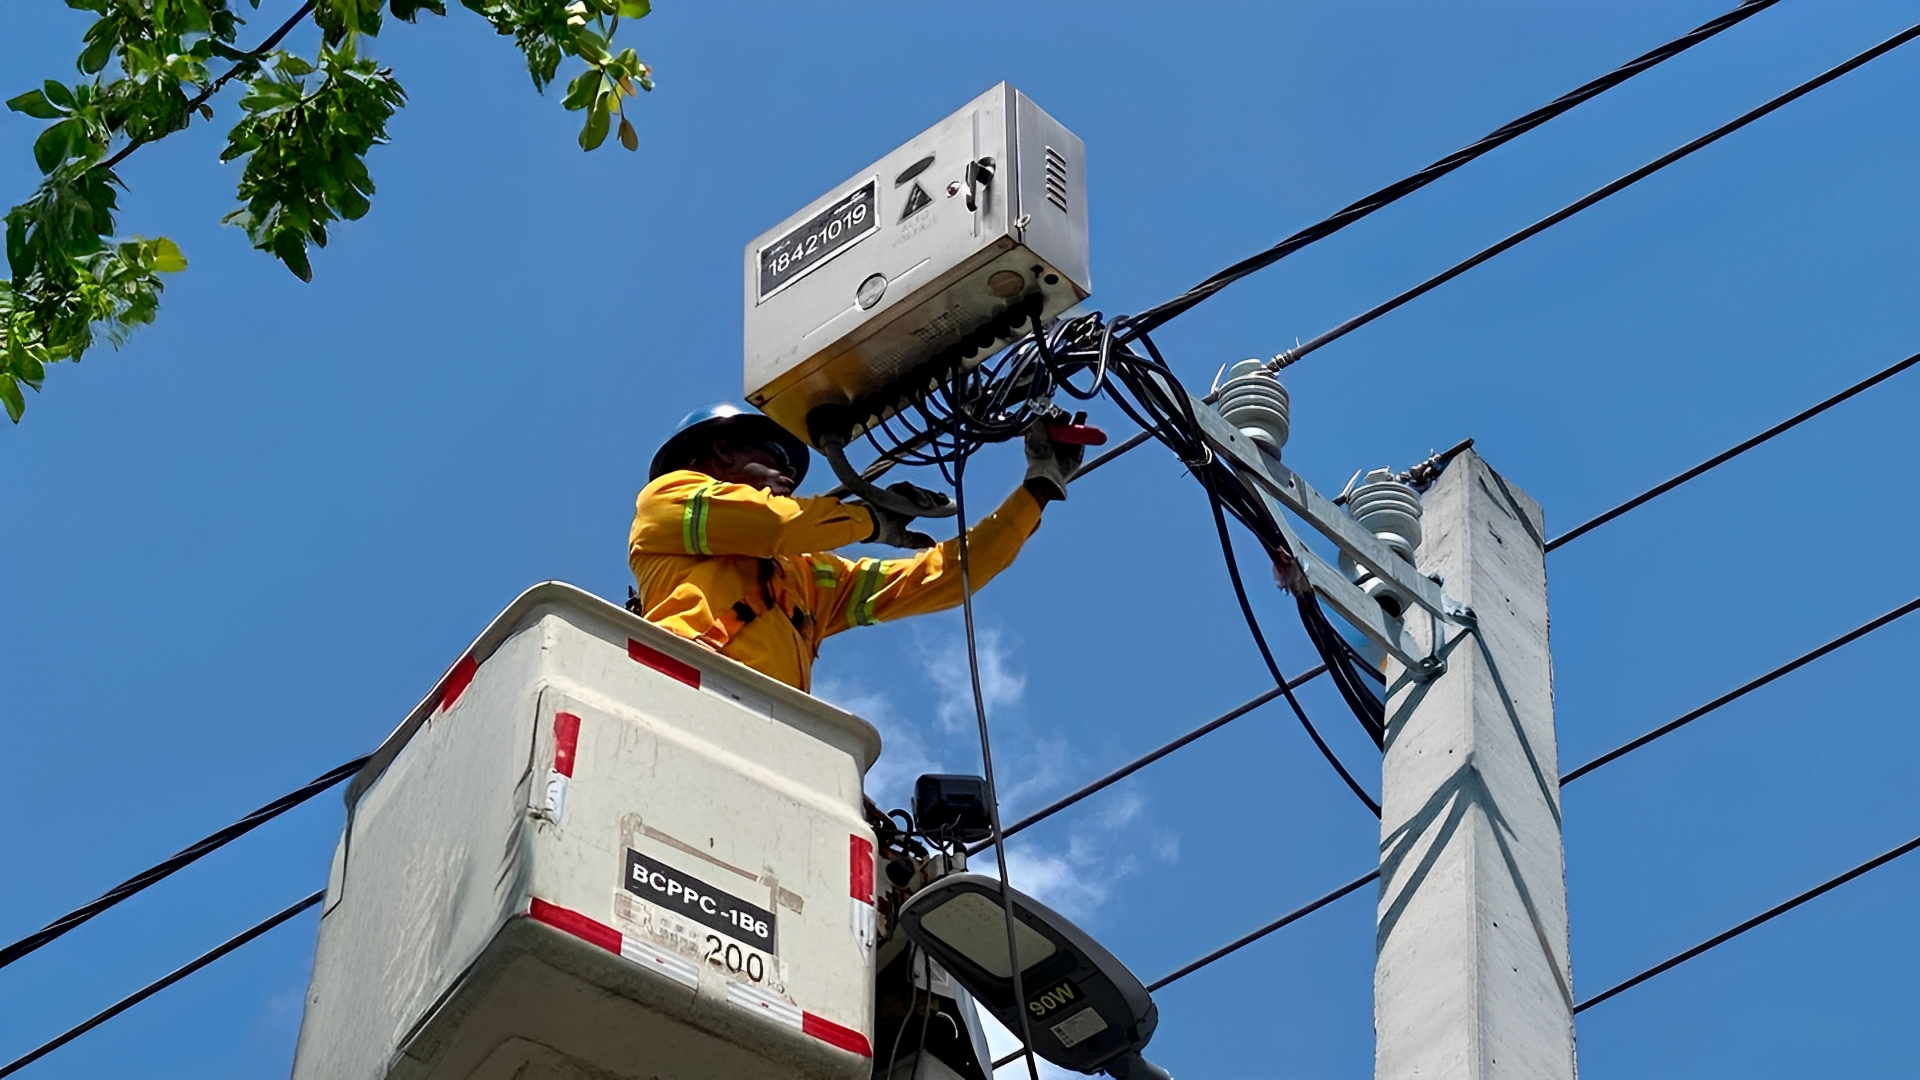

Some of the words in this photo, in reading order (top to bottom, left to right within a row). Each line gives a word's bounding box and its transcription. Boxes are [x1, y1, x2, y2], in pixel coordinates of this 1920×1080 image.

[769, 203, 867, 276] 18421019
[704, 934, 764, 983] 200
[1029, 982, 1075, 1016] 90W
